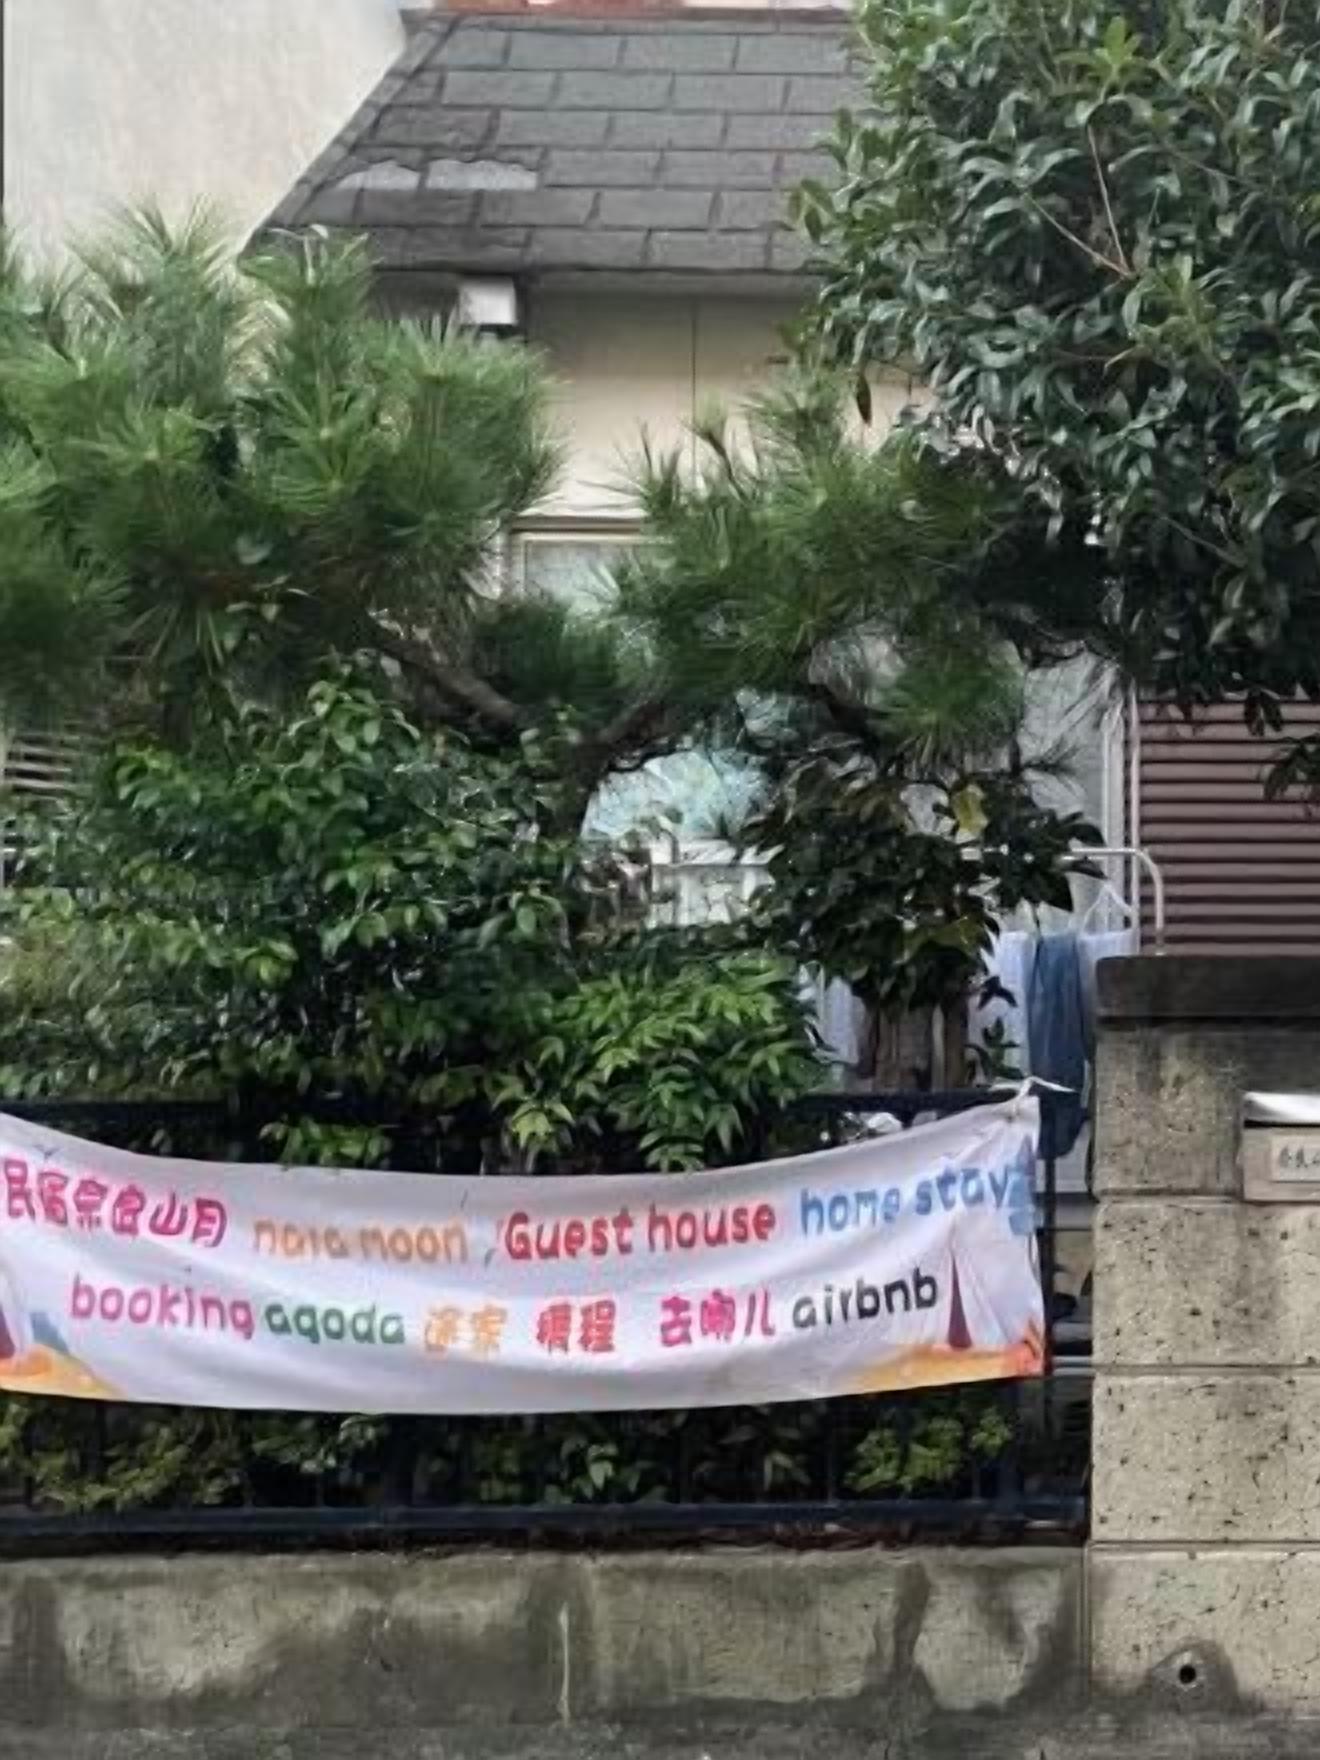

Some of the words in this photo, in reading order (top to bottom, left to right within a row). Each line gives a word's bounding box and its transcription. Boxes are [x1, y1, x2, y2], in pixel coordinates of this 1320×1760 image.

[359, 1220, 469, 1264] moon
[504, 1207, 634, 1260] Guest
[648, 1201, 777, 1251] house
[71, 1270, 255, 1340] booking
[265, 1301, 406, 1345] agoda
[791, 1267, 940, 1329] airbnb
